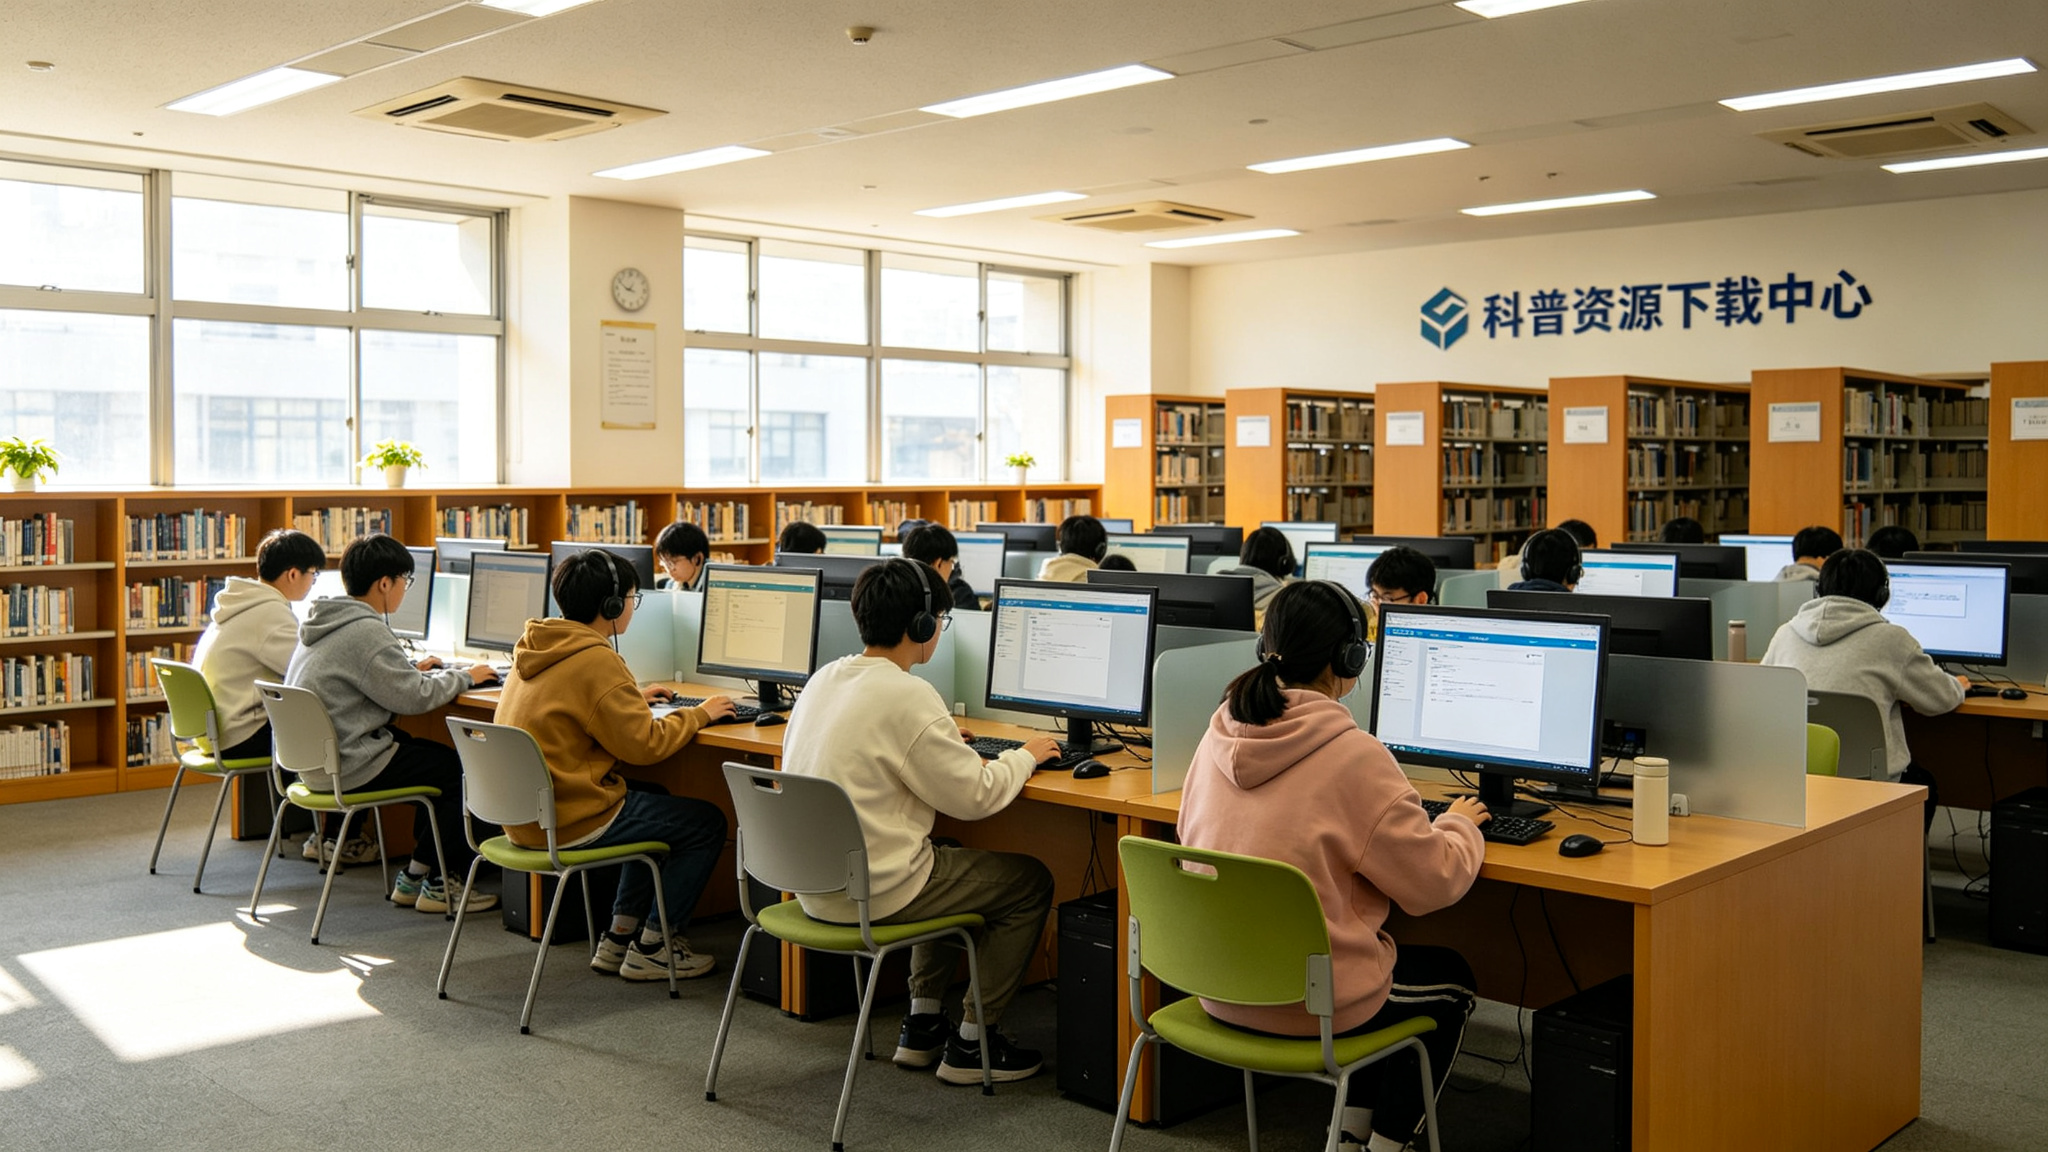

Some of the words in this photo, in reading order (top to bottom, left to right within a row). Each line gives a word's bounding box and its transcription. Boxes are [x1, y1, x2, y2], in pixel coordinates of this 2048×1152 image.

[1483, 269, 1873, 338] 科普资源下载中心
